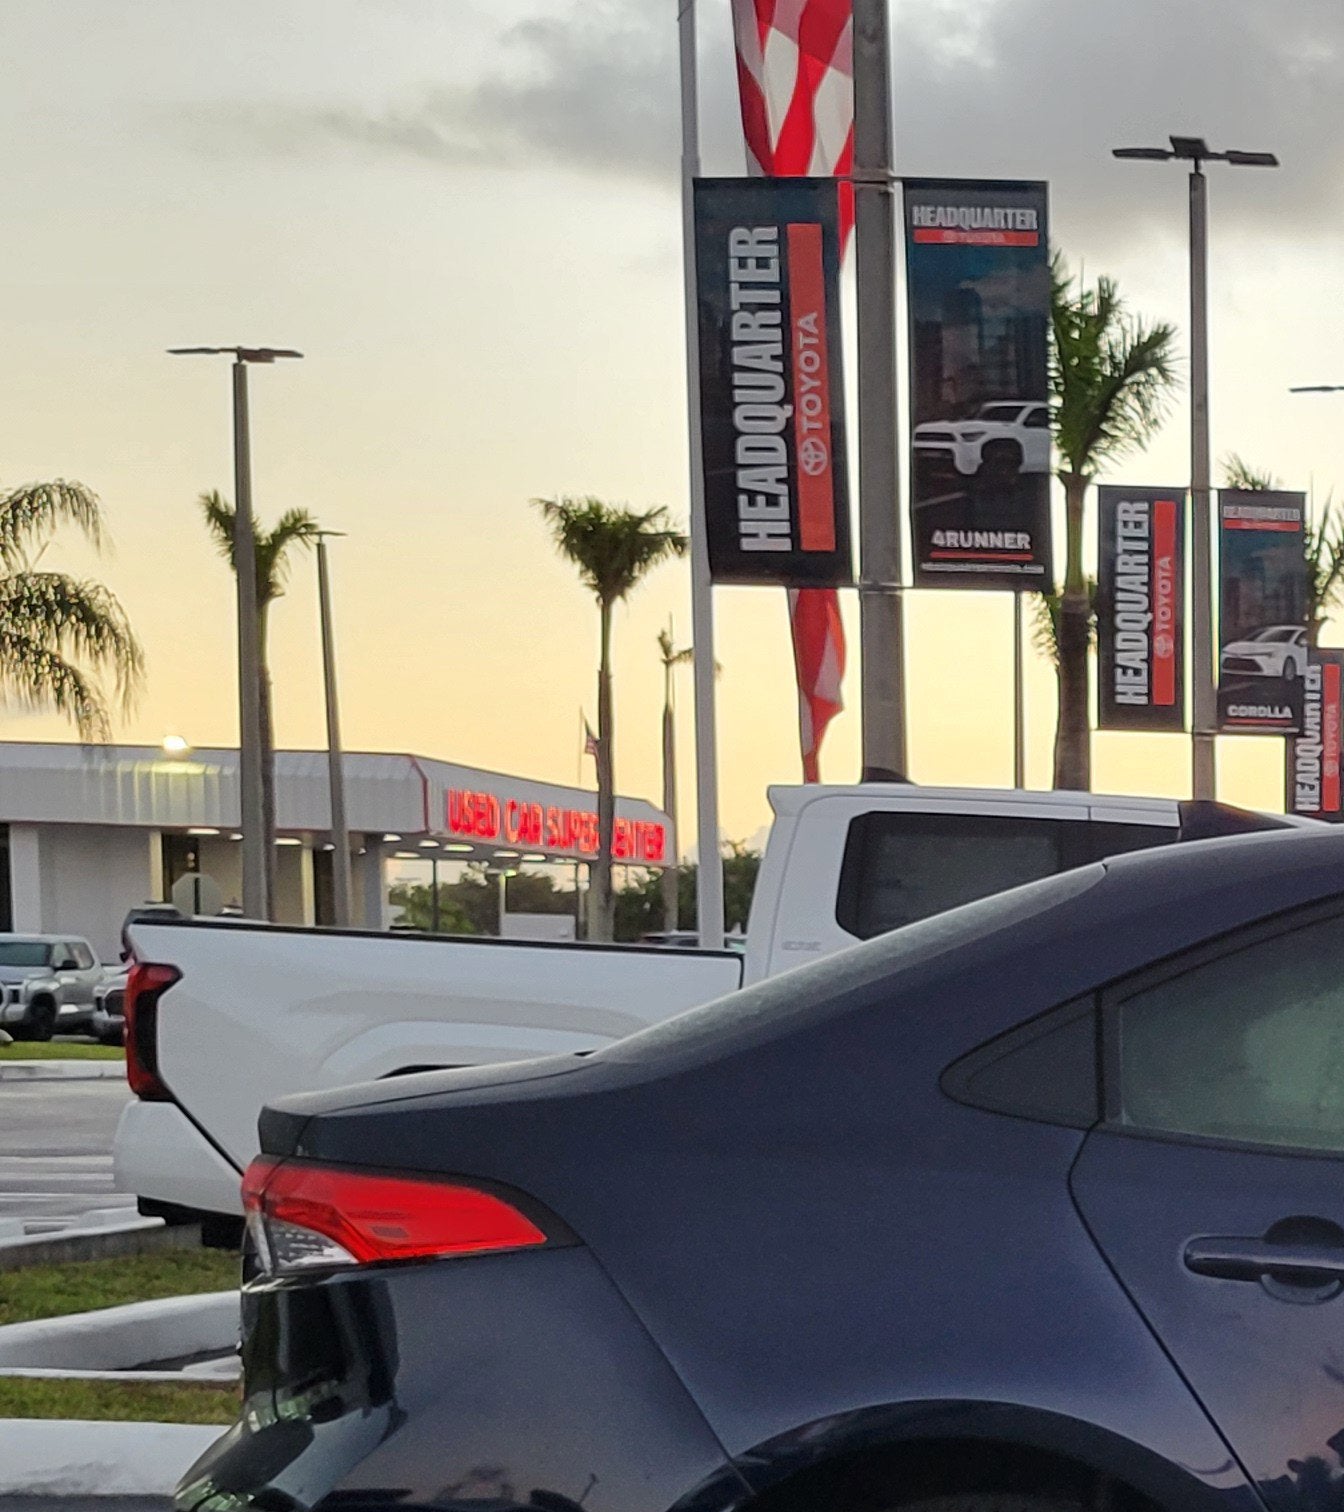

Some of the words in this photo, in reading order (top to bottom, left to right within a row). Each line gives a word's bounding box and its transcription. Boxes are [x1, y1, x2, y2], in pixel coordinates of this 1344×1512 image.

[912, 205, 1038, 230] HEADQUARTER
[728, 225, 793, 552] HEADQUARTER
[797, 312, 822, 434] TOYOTA
[931, 529, 1031, 549] 4RUNNER
[1114, 501, 1153, 705] HEADQUARTER
[1156, 556, 1172, 630] TOYOTA
[1227, 704, 1293, 719] COROLLA
[447, 788, 499, 838] USED
[504, 799, 544, 846] CAR
[611, 816, 666, 862] ENTER
